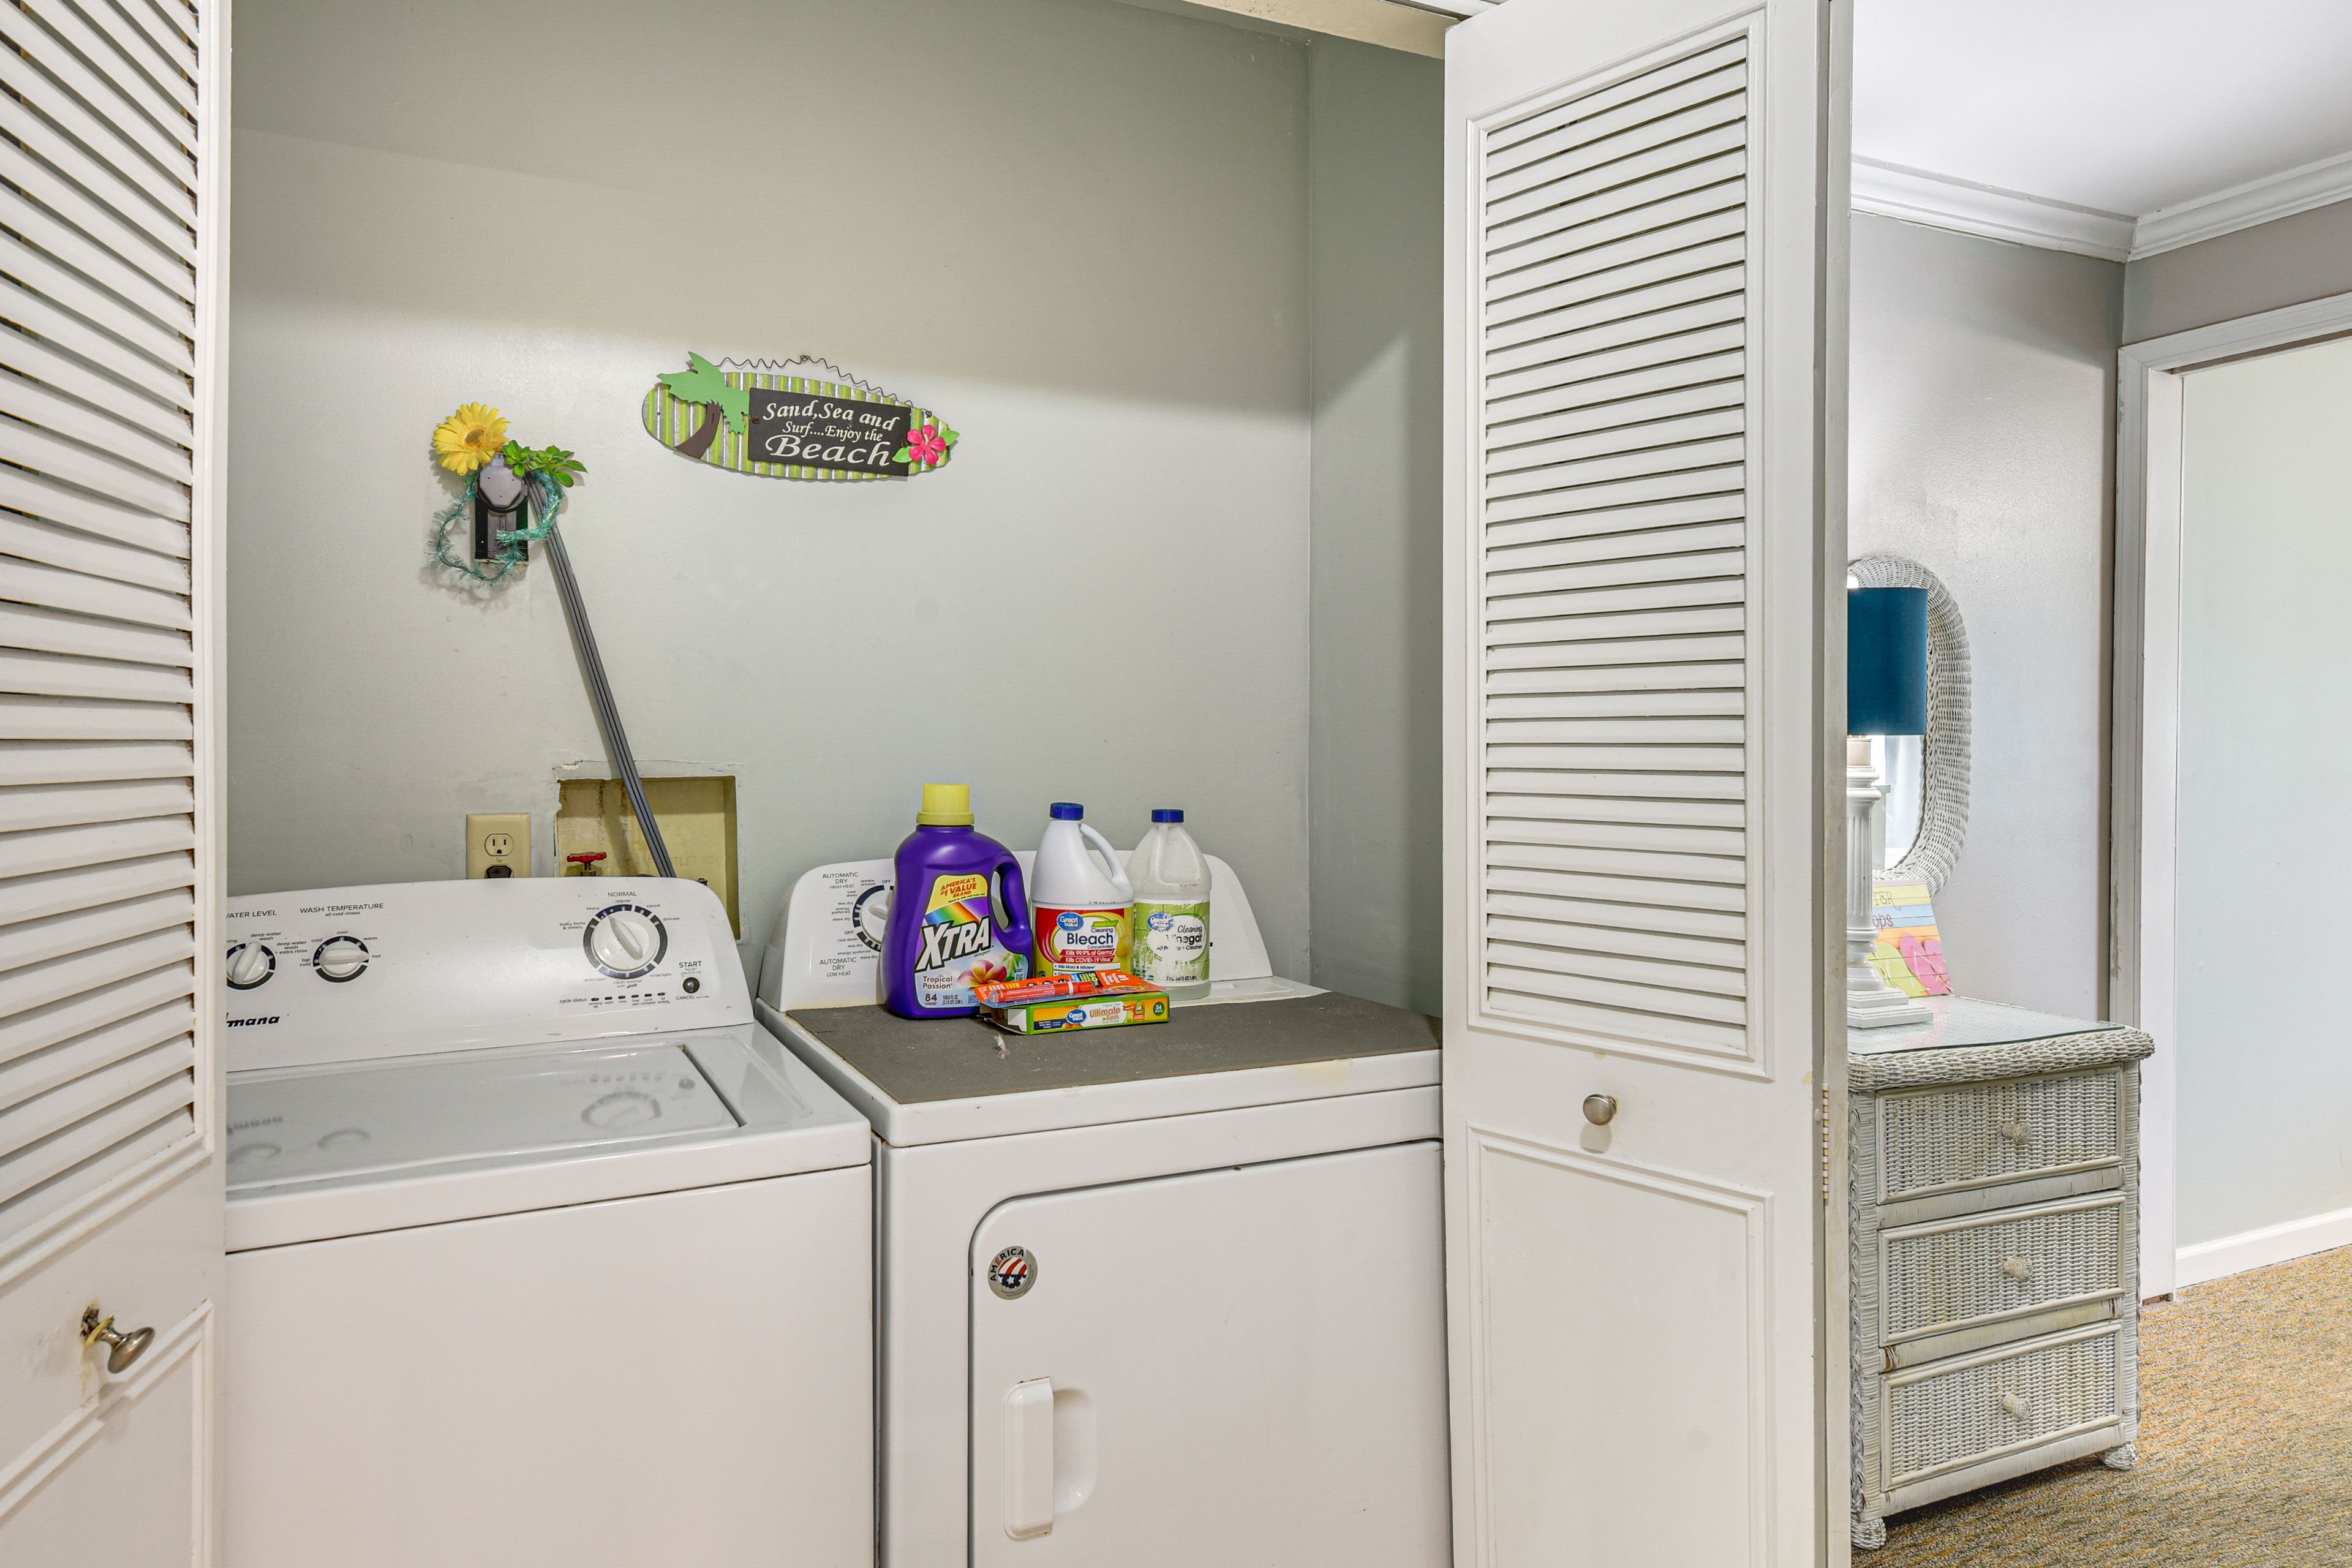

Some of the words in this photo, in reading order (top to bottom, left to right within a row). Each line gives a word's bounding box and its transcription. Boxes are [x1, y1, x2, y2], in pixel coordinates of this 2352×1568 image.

[859, 413, 900, 431] and
[864, 429, 883, 441] the
[765, 434, 891, 467] Beach
[941, 877, 976, 891] AMERICA'S
[949, 883, 977, 894] VALUE
[327, 903, 384, 911] TEMPERATURE
[1872, 891, 1901, 911] TER
[1872, 913, 1894, 932] ops
[1177, 925, 1203, 935] Cleaning
[915, 916, 991, 971] XTRA
[1067, 933, 1114, 944] Bleach
[1090, 1006, 1120, 1018] Ultimate
[226, 1012, 280, 1027] mana
[990, 1248, 1024, 1281] AMERICA
